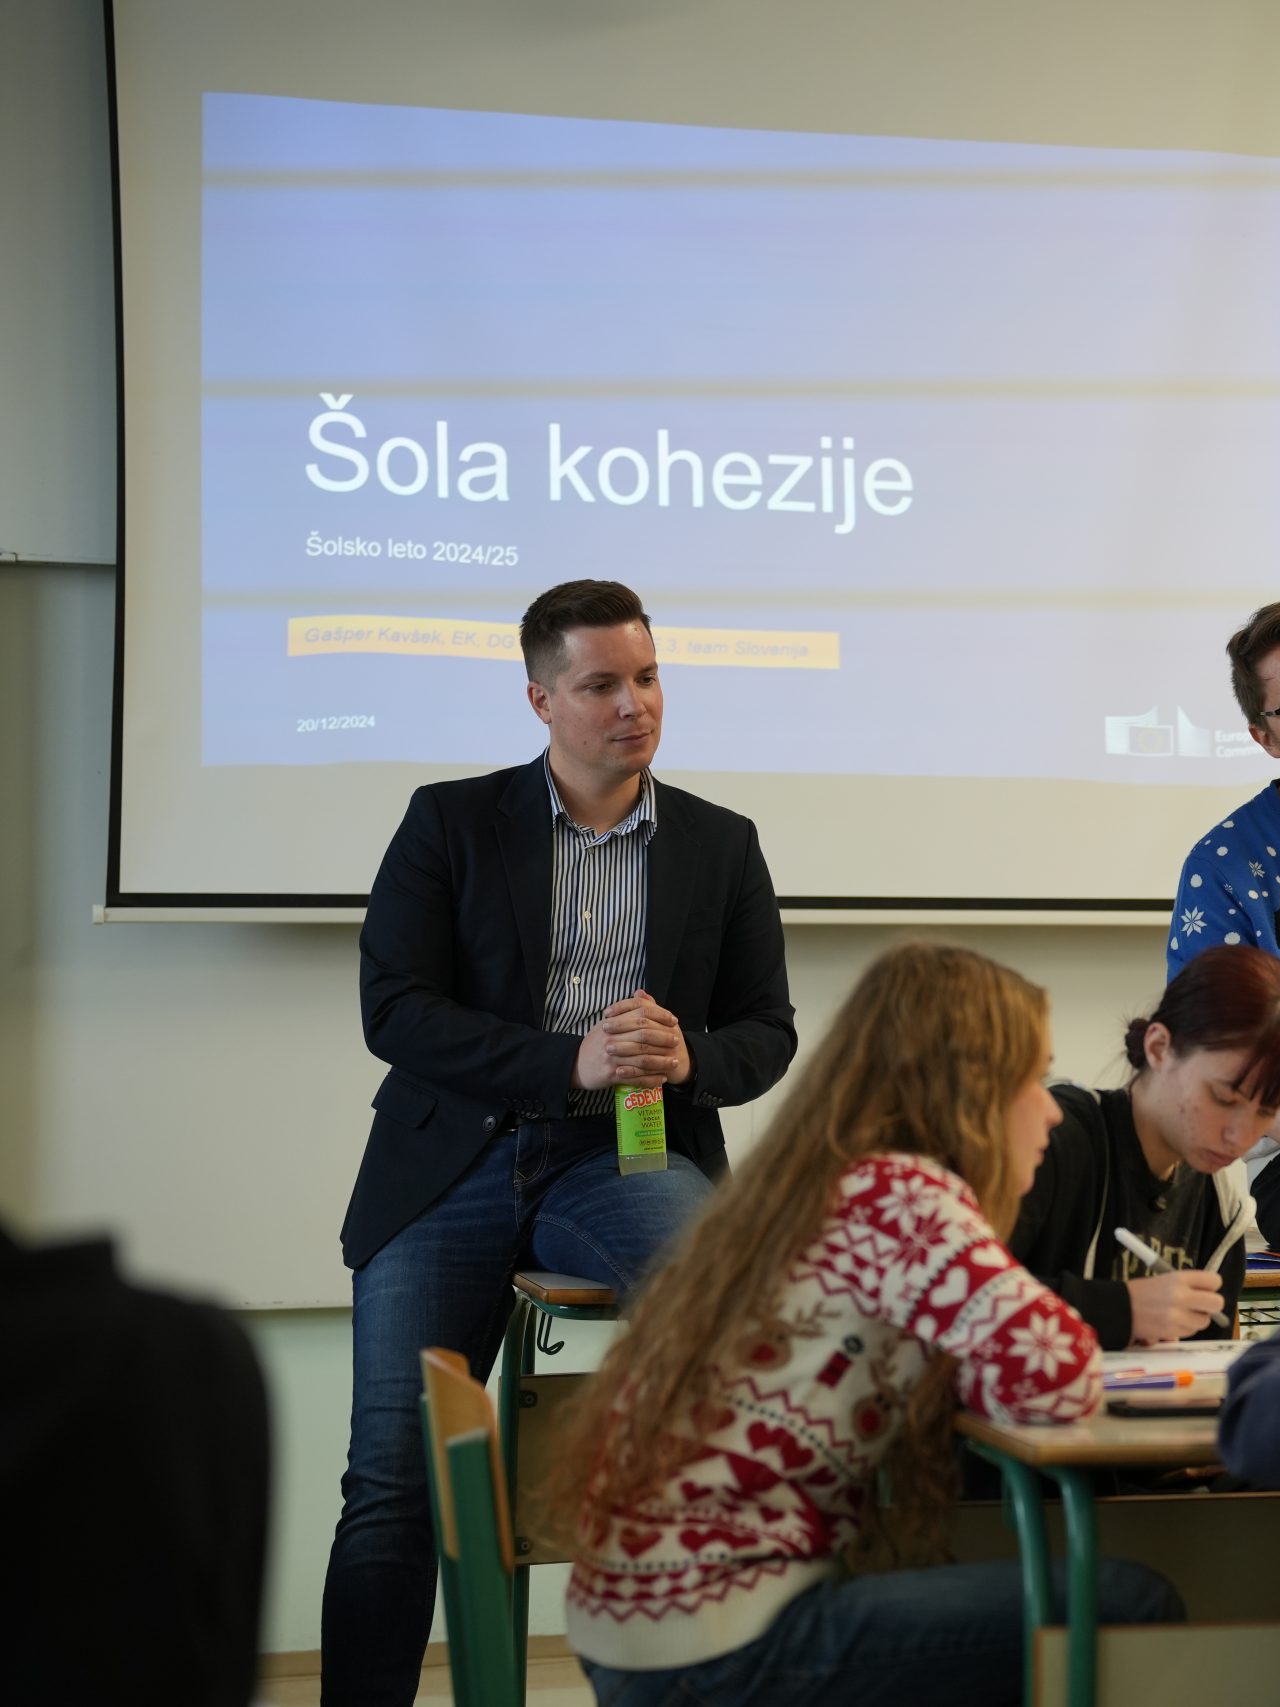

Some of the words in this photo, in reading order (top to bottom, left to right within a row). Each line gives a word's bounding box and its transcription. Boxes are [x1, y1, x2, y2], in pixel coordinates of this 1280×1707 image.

[304, 392, 510, 503] Šola
[548, 423, 914, 535] kohezije
[305, 531, 382, 559] Šolsko
[387, 536, 427, 561] leto
[433, 541, 519, 567] 2024/25
[304, 627, 374, 644] Gašper
[378, 626, 446, 646] Kavšek,
[486, 633, 516, 649] DG
[686, 640, 730, 654] team
[735, 641, 809, 660] Slovenija
[296, 715, 376, 733] 20/12/2024
[1214, 730, 1251, 744] Europ
[624, 1087, 662, 1110] CEDEVIT
